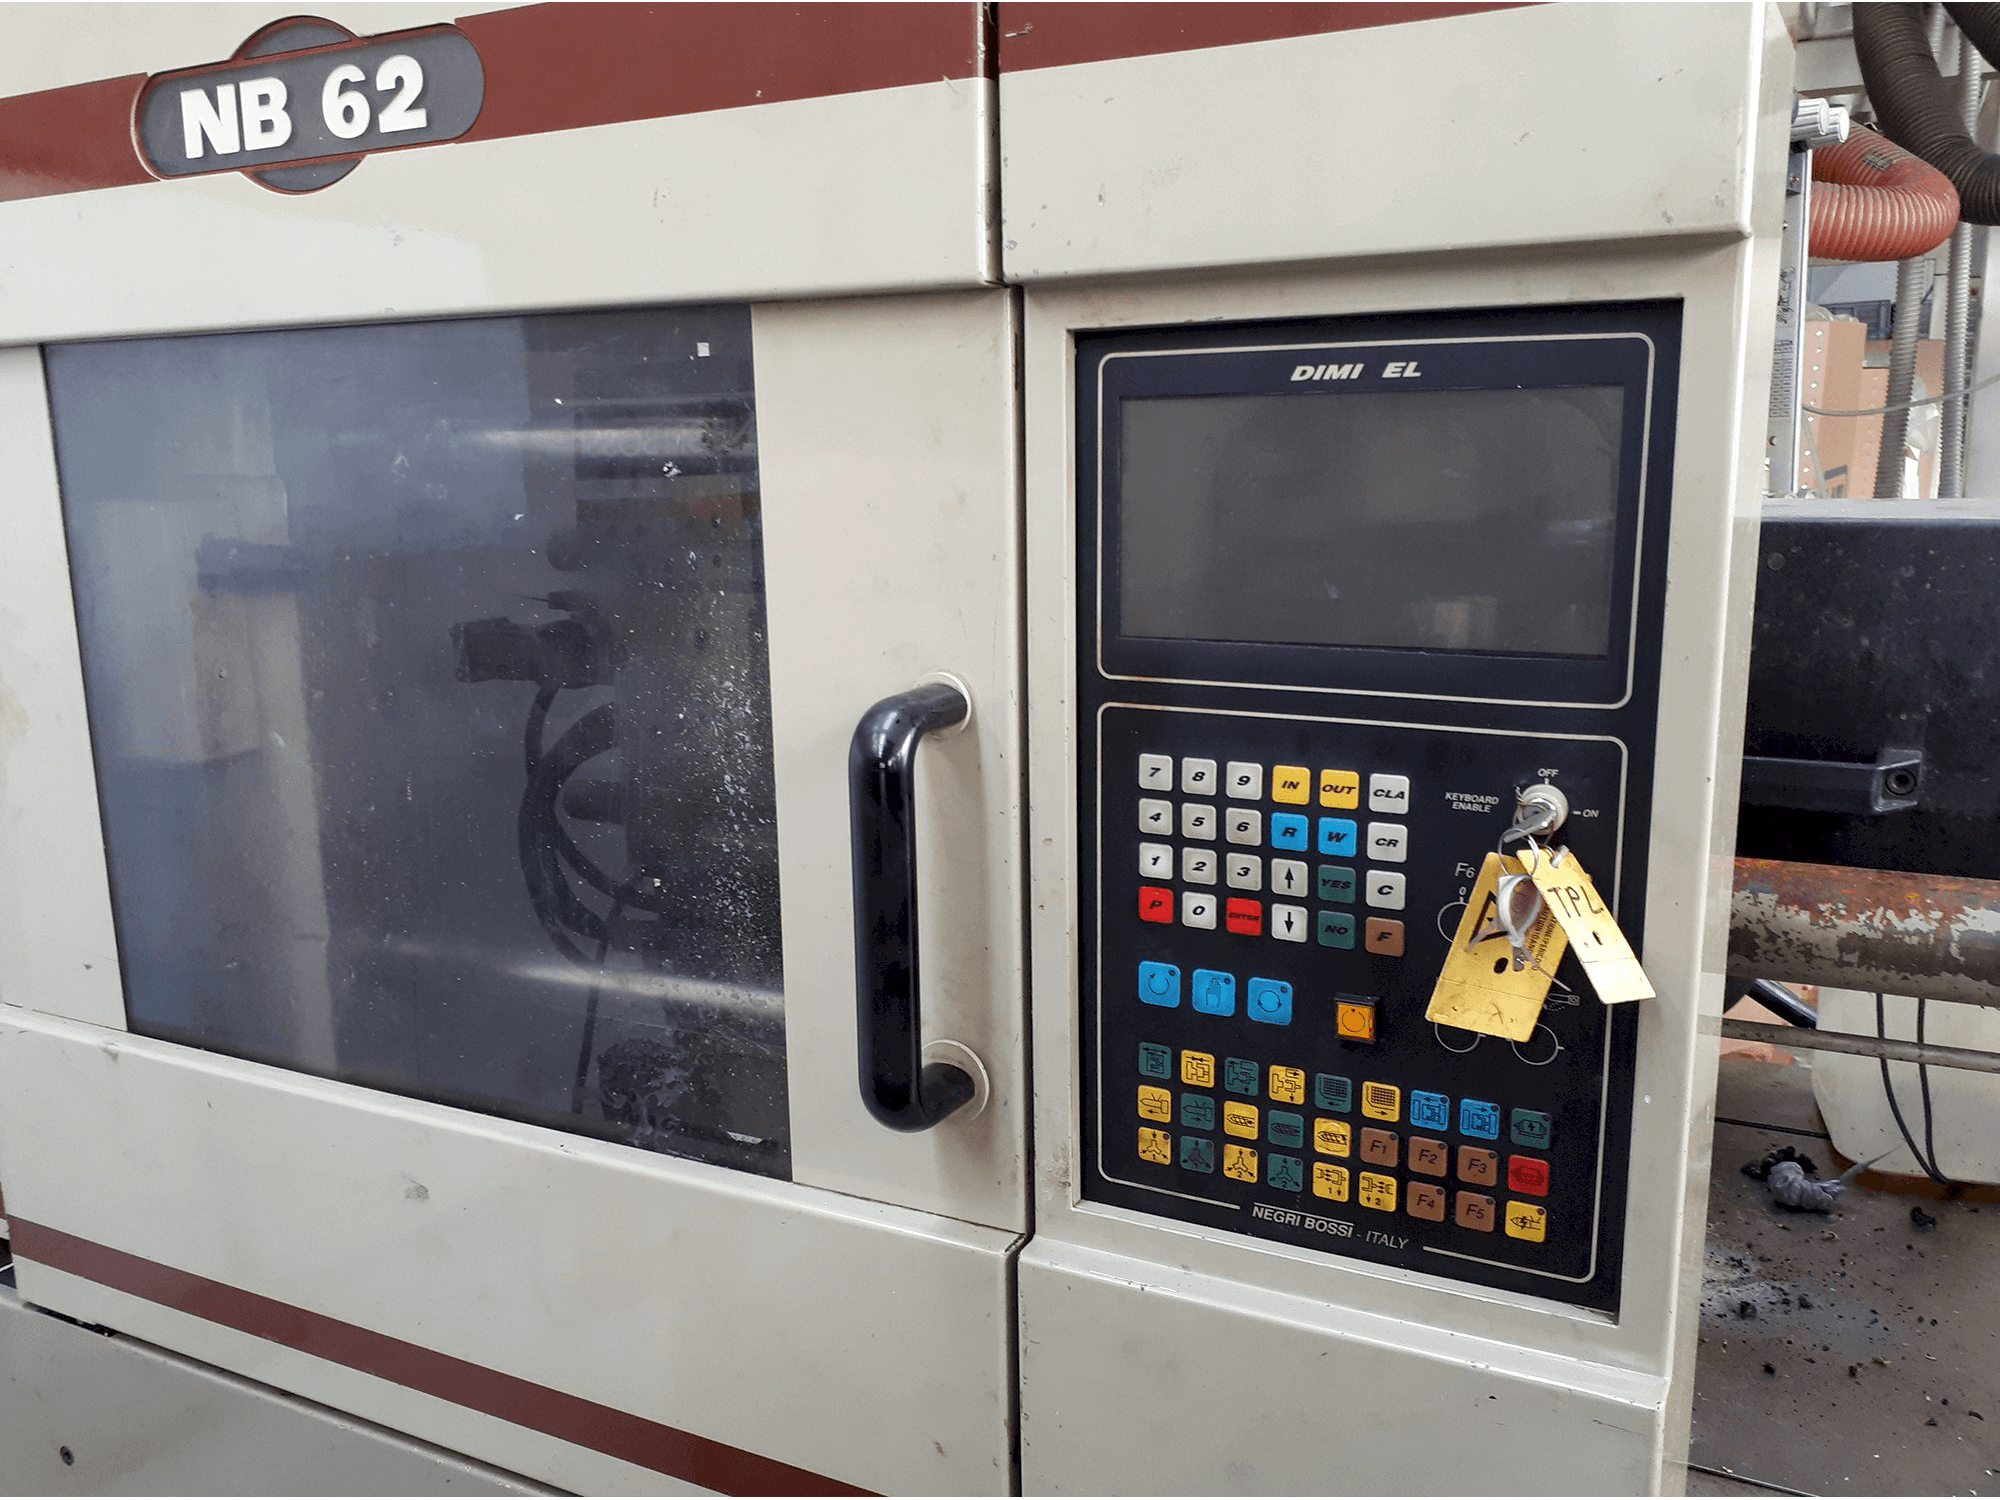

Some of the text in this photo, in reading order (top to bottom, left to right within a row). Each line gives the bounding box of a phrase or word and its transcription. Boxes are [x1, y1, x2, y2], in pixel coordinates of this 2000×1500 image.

[180, 54, 428, 159] NB 62
[1290, 361, 1422, 381] DIMI EL
[1149, 767, 1161, 777] 7
[1192, 771, 1206, 782] 8
[1537, 768, 1559, 778] OFF
[1236, 775, 1251, 786] 9
[1281, 780, 1300, 790] IN
[1321, 784, 1356, 795] OUT
[1373, 788, 1405, 799] CLA
[1445, 792, 1499, 805] KEYBOARD
[1452, 802, 1491, 813] ENABLE
[1149, 812, 1162, 822] 4
[1582, 809, 1600, 818] ON
[1191, 816, 1205, 827] 5
[1236, 821, 1250, 832] 6
[1281, 827, 1298, 837] R
[1327, 831, 1347, 843] W
[1375, 837, 1399, 848] CR
[1151, 855, 1161, 866] 1
[1192, 861, 1207, 872] 2
[1236, 866, 1251, 877] 3
[1455, 862, 1476, 878] F6
[1321, 878, 1352, 889] YES
[1377, 885, 1394, 895] C
[1149, 899, 1163, 909] P
[1547, 885, 1604, 918] TPL
[1324, 924, 1348, 935] NO
[1376, 932, 1392, 942] F
[1370, 1139, 1387, 1154] F1
[1418, 1149, 1438, 1164] F2
[1467, 1158, 1487, 1174] F3
[1416, 1194, 1435, 1209] F4
[1466, 1204, 1485, 1220] F5
[1252, 1206, 1300, 1227] NEGRI
[1304, 1217, 1353, 1238] BOSSI
[1365, 1230, 1409, 1250] ITALY
